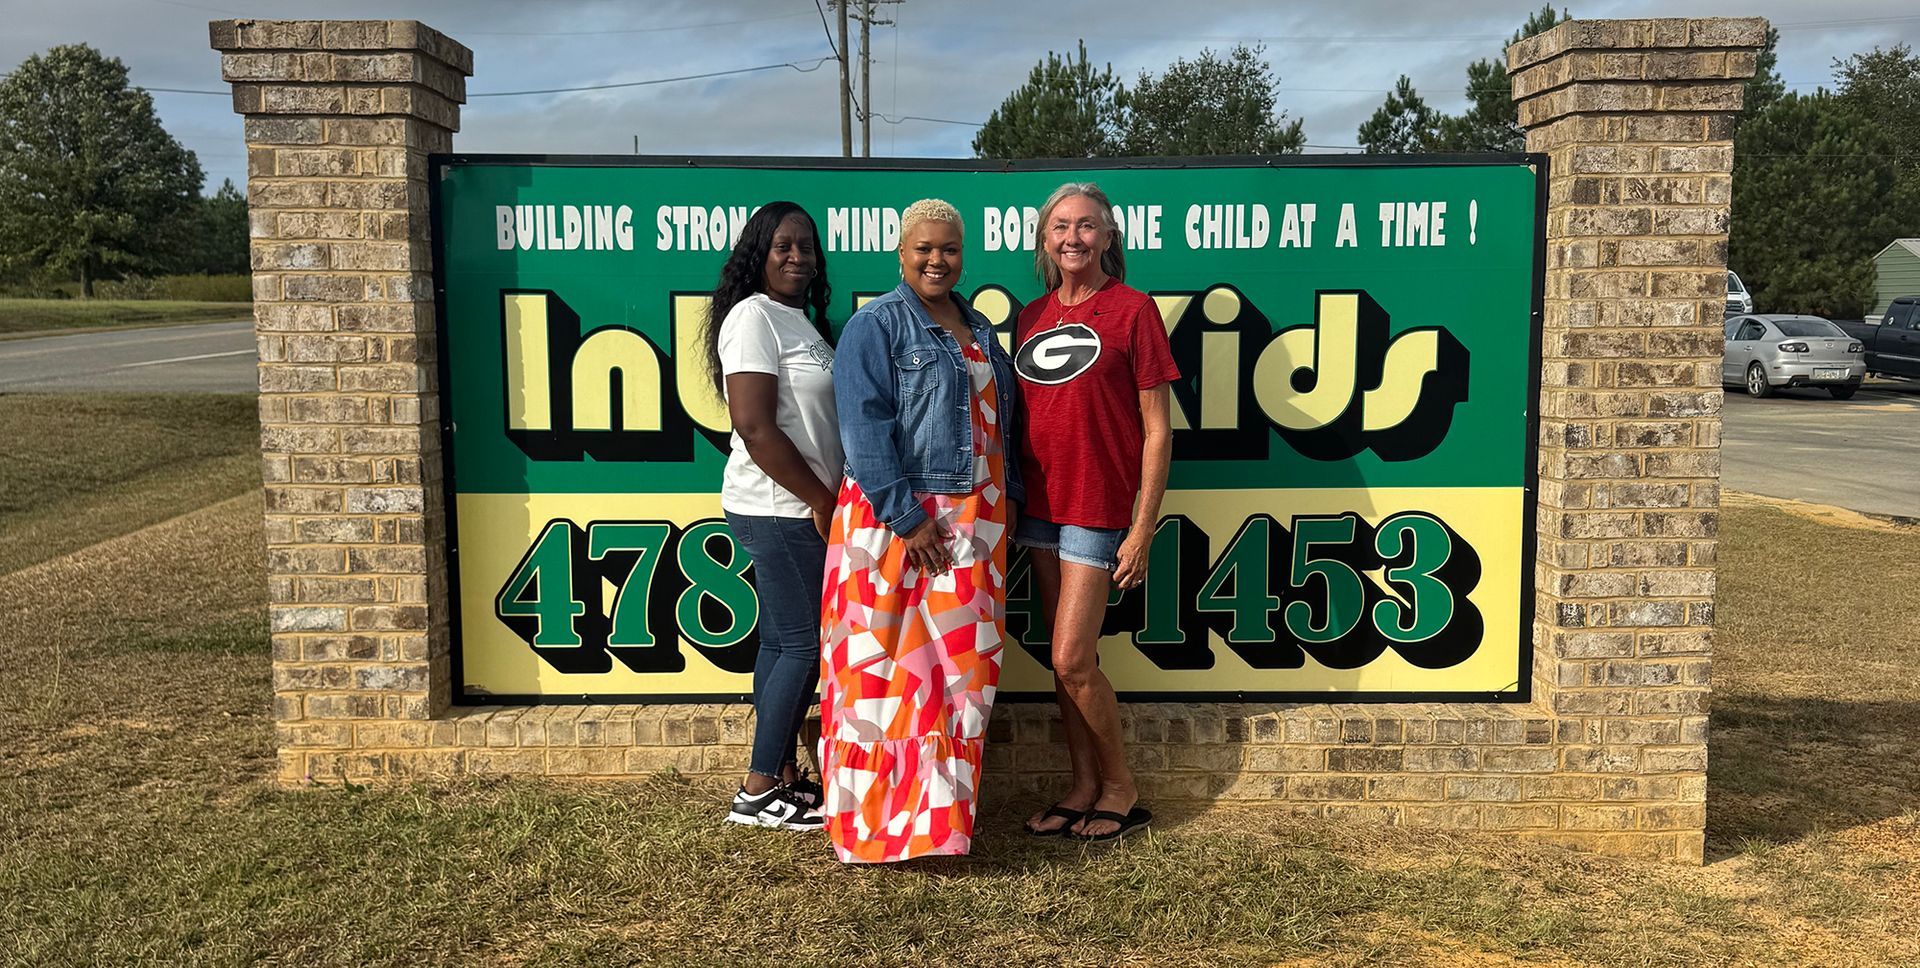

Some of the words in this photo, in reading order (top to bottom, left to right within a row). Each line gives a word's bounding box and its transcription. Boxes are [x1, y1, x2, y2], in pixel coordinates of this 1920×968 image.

[497, 205, 634, 251] BUILDING
[656, 205, 762, 251] STRON
[827, 207, 911, 252] MIND
[1185, 204, 1270, 250] CHILD
[1279, 203, 1316, 248] AT
[1335, 203, 1359, 248] A
[1379, 201, 1447, 247] TIME
